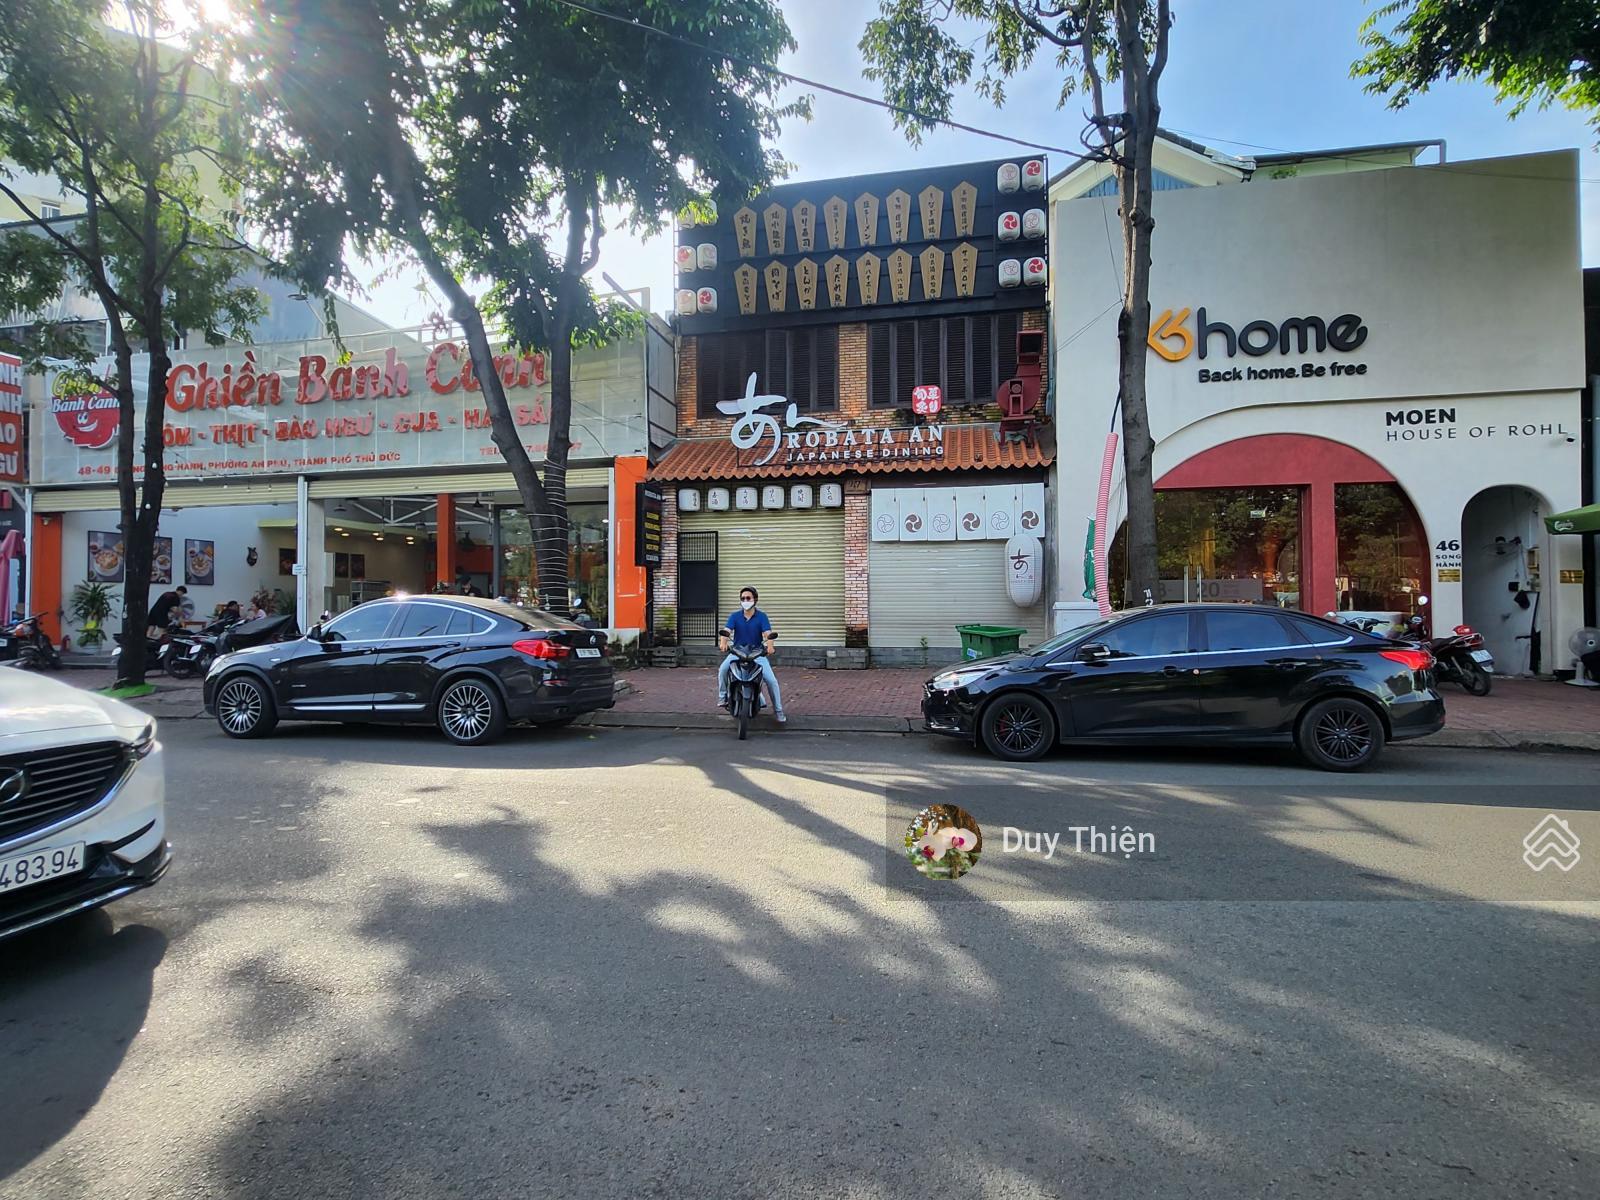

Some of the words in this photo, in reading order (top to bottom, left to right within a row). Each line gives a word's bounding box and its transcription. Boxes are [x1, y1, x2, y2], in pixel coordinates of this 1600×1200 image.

[803, 266, 811, 305] とんかつ
[1197, 306, 1368, 360] home
[165, 350, 282, 412] Ghiền
[1199, 367, 1243, 383] Back
[1330, 361, 1368, 376] free
[209, 423, 258, 448] THỊT
[275, 415, 318, 441] BÀO
[516, 394, 549, 426] SẢ
[1386, 408, 1456, 426] MOEN
[787, 428, 894, 449] ROBATA
[909, 425, 944, 443] AN
[1387, 428, 1456, 442] HOUSE
[1469, 426, 1496, 438] OF
[1509, 424, 1568, 436] ROHL
[355, 451, 375, 462] THỦ
[379, 451, 401, 461] ĐỨC
[787, 449, 874, 461] JAPANESE
[883, 446, 944, 457] DINING
[1436, 539, 1460, 551] 46
